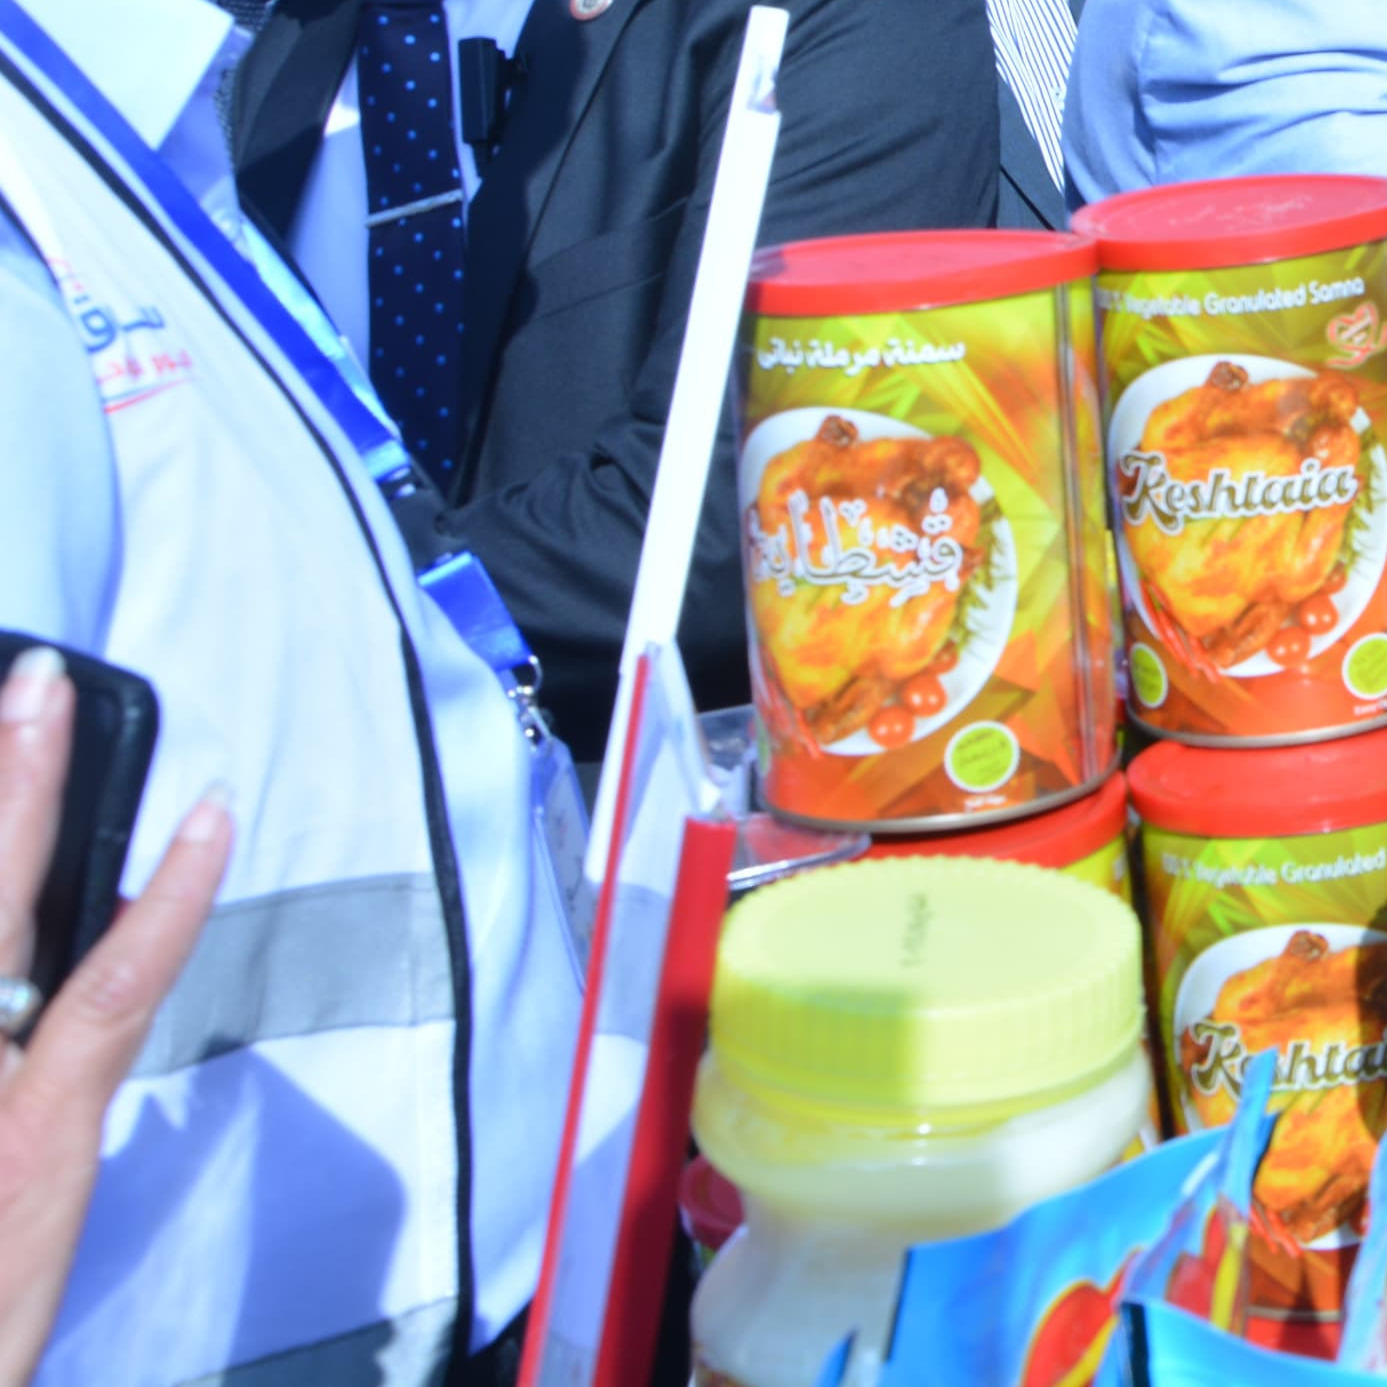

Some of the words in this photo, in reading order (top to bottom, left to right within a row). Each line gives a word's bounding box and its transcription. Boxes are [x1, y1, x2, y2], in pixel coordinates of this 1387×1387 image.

[1204, 282, 1307, 317] Granulated
[1308, 277, 1366, 305] Samna
[1120, 450, 1359, 534] Keshtaia
[1281, 846, 1387, 885] Granulated
